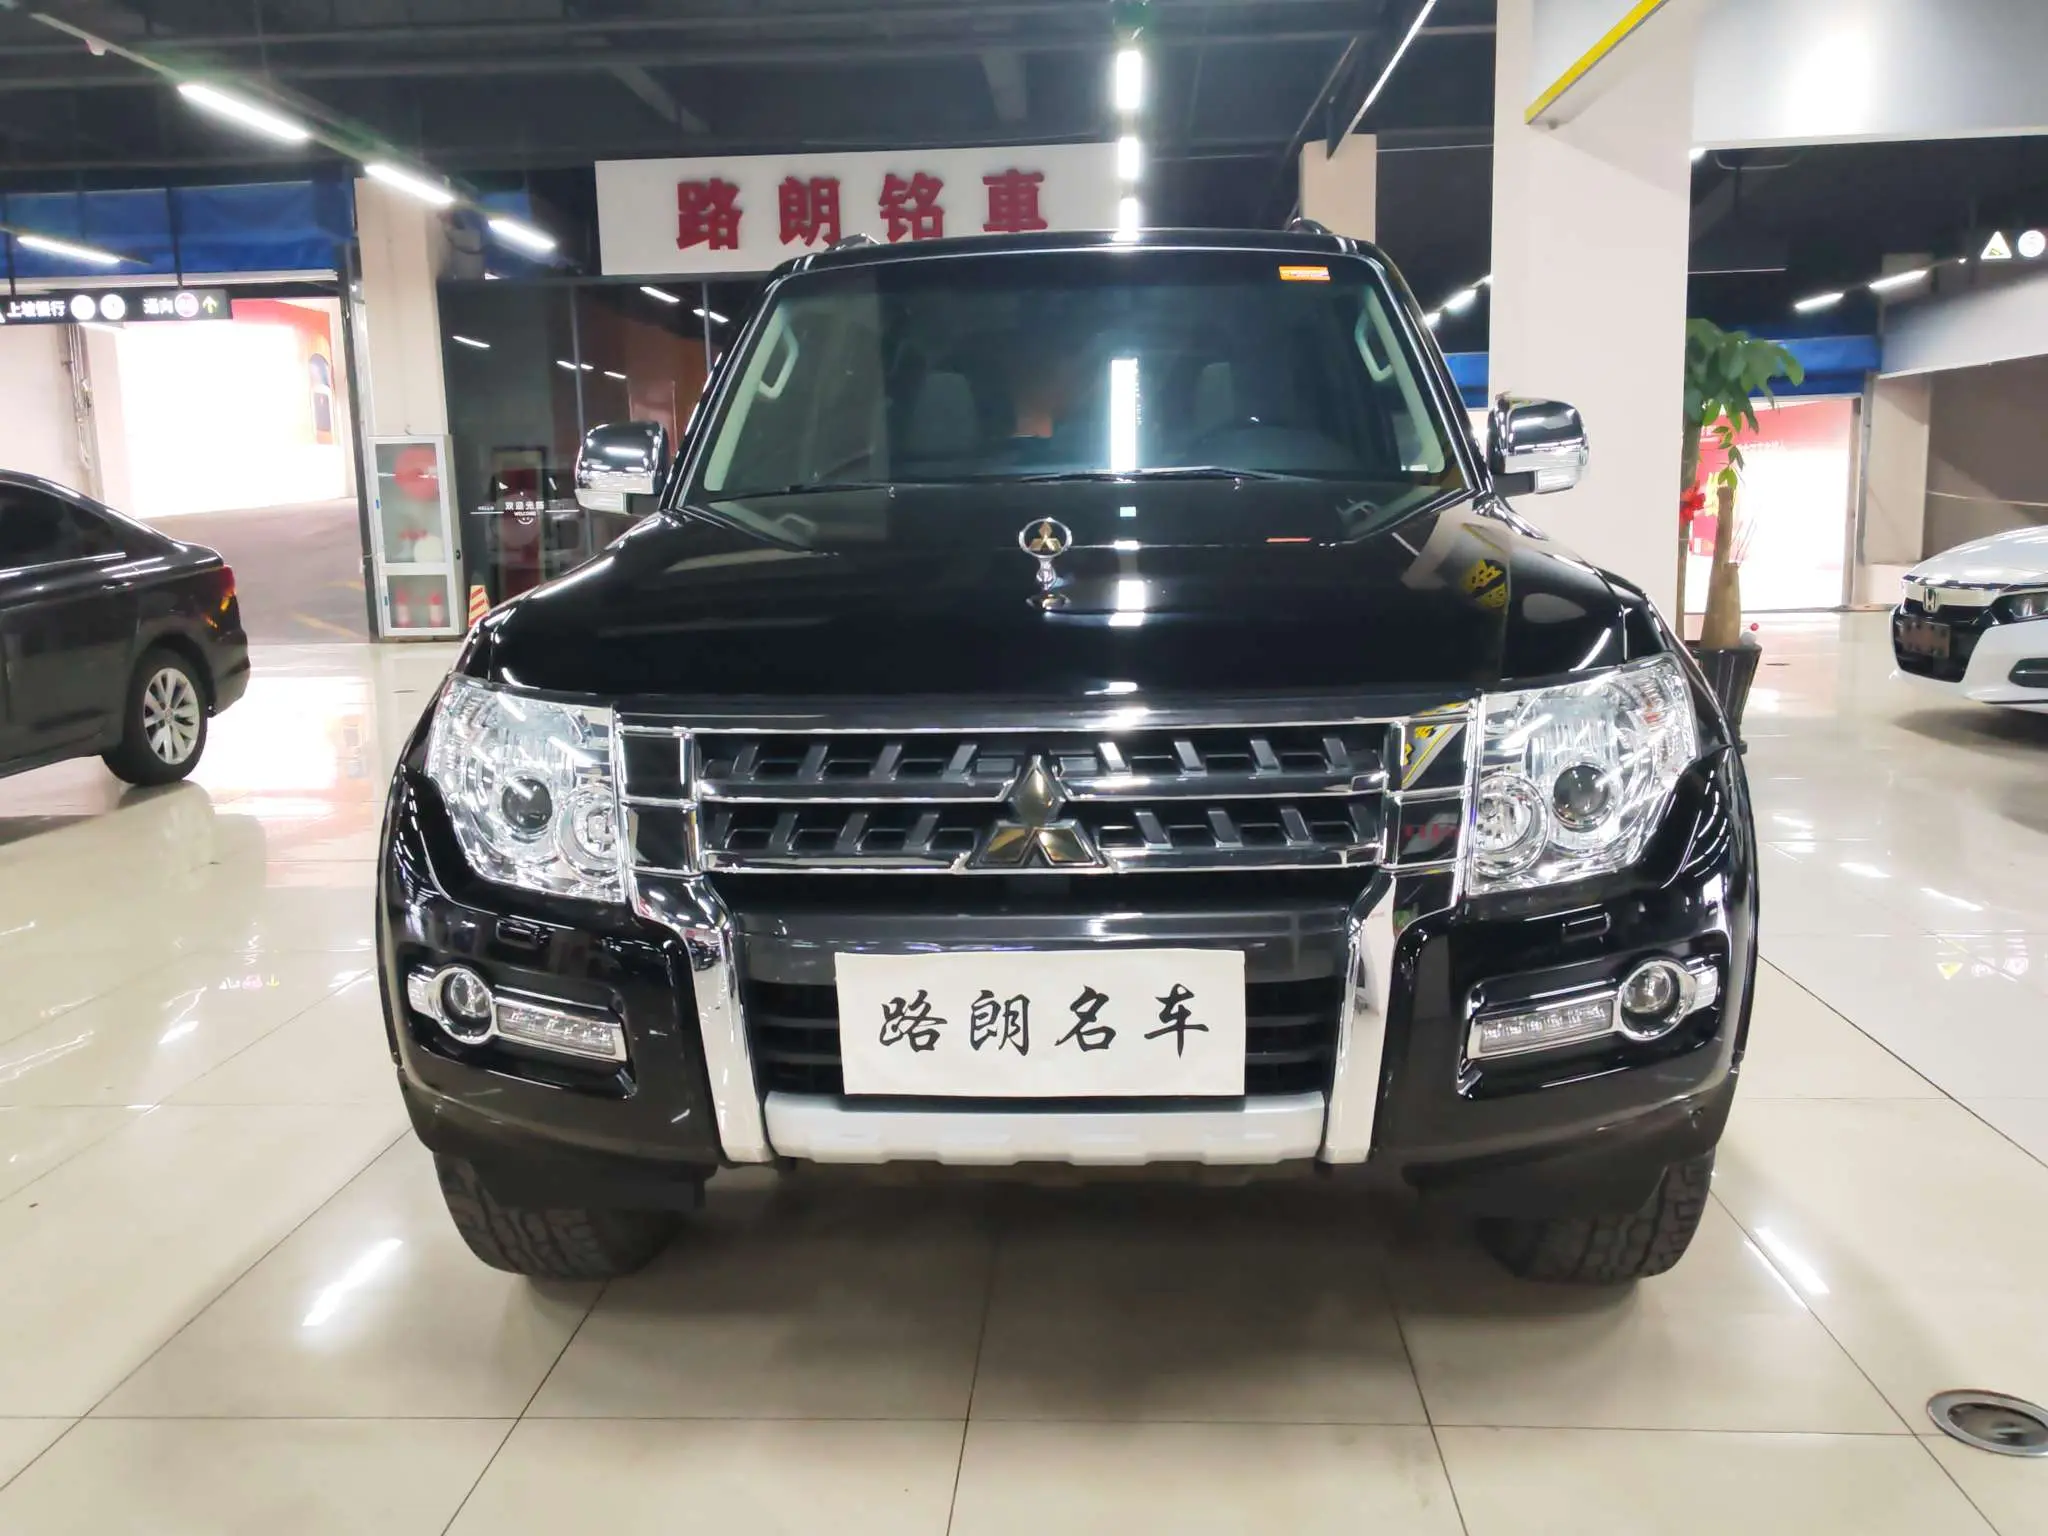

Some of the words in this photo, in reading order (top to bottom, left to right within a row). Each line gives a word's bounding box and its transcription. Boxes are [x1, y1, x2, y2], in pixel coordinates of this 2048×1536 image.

[677, 169, 1048, 250] 路朗铭車
[879, 983, 1210, 1058] 路朗名车
